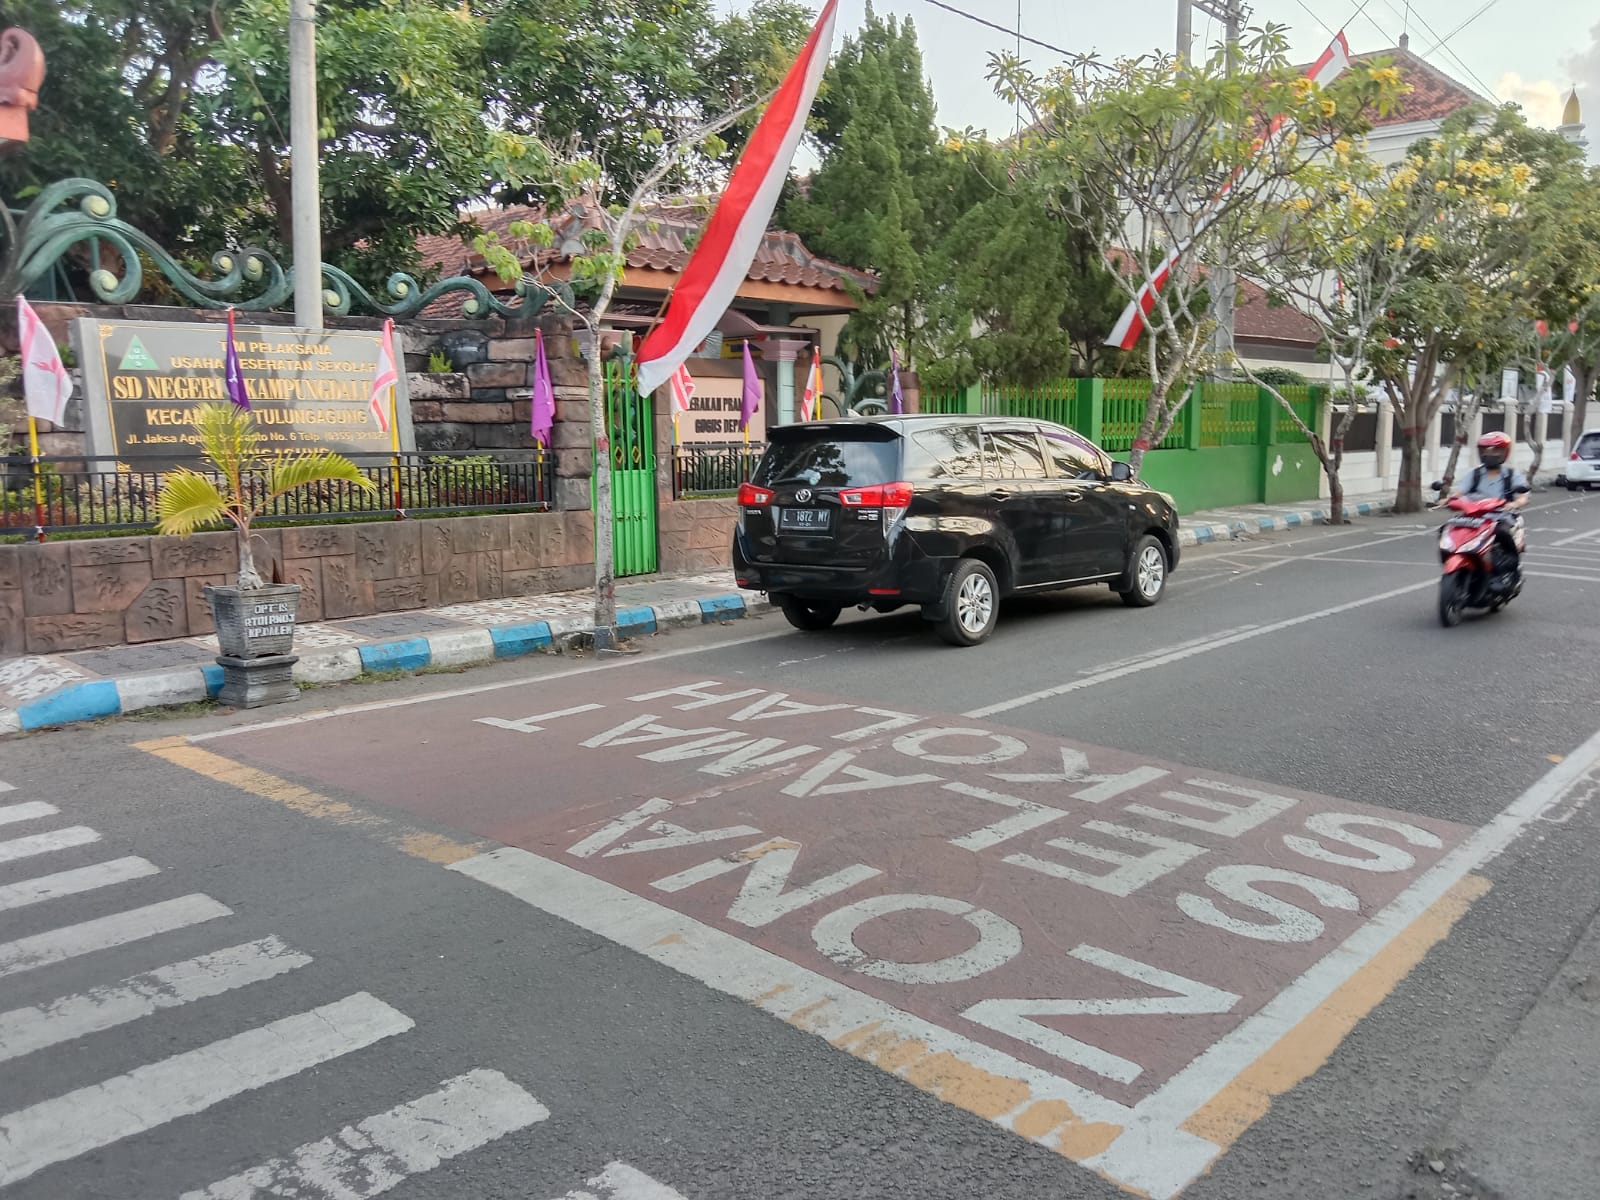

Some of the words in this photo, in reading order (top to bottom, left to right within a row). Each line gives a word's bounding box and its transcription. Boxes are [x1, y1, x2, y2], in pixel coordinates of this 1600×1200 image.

[218, 340, 246, 353] TM
[250, 342, 332, 355] PELAKSANA
[170, 357, 224, 370] USAHA
[239, 358, 312, 371] ESEHATAN
[113, 376, 143, 399] SD
[145, 377, 225, 399] NEGERI
[689, 397, 721, 411] ERAKAN
[254, 409, 369, 424] TULUNGAGUNG
[695, 419, 722, 434] GUGUS
[143, 433, 177, 444] Jaksa
[270, 433, 288, 442] No.
[290, 433, 297, 441] 6
[783, 510, 789, 521] L
[796, 510, 813, 522] 1872
[624, 680, 1444, 873] SEKOLAH
[472, 703, 1361, 943] SELAMAT
[565, 796, 1242, 1085] ZONA
